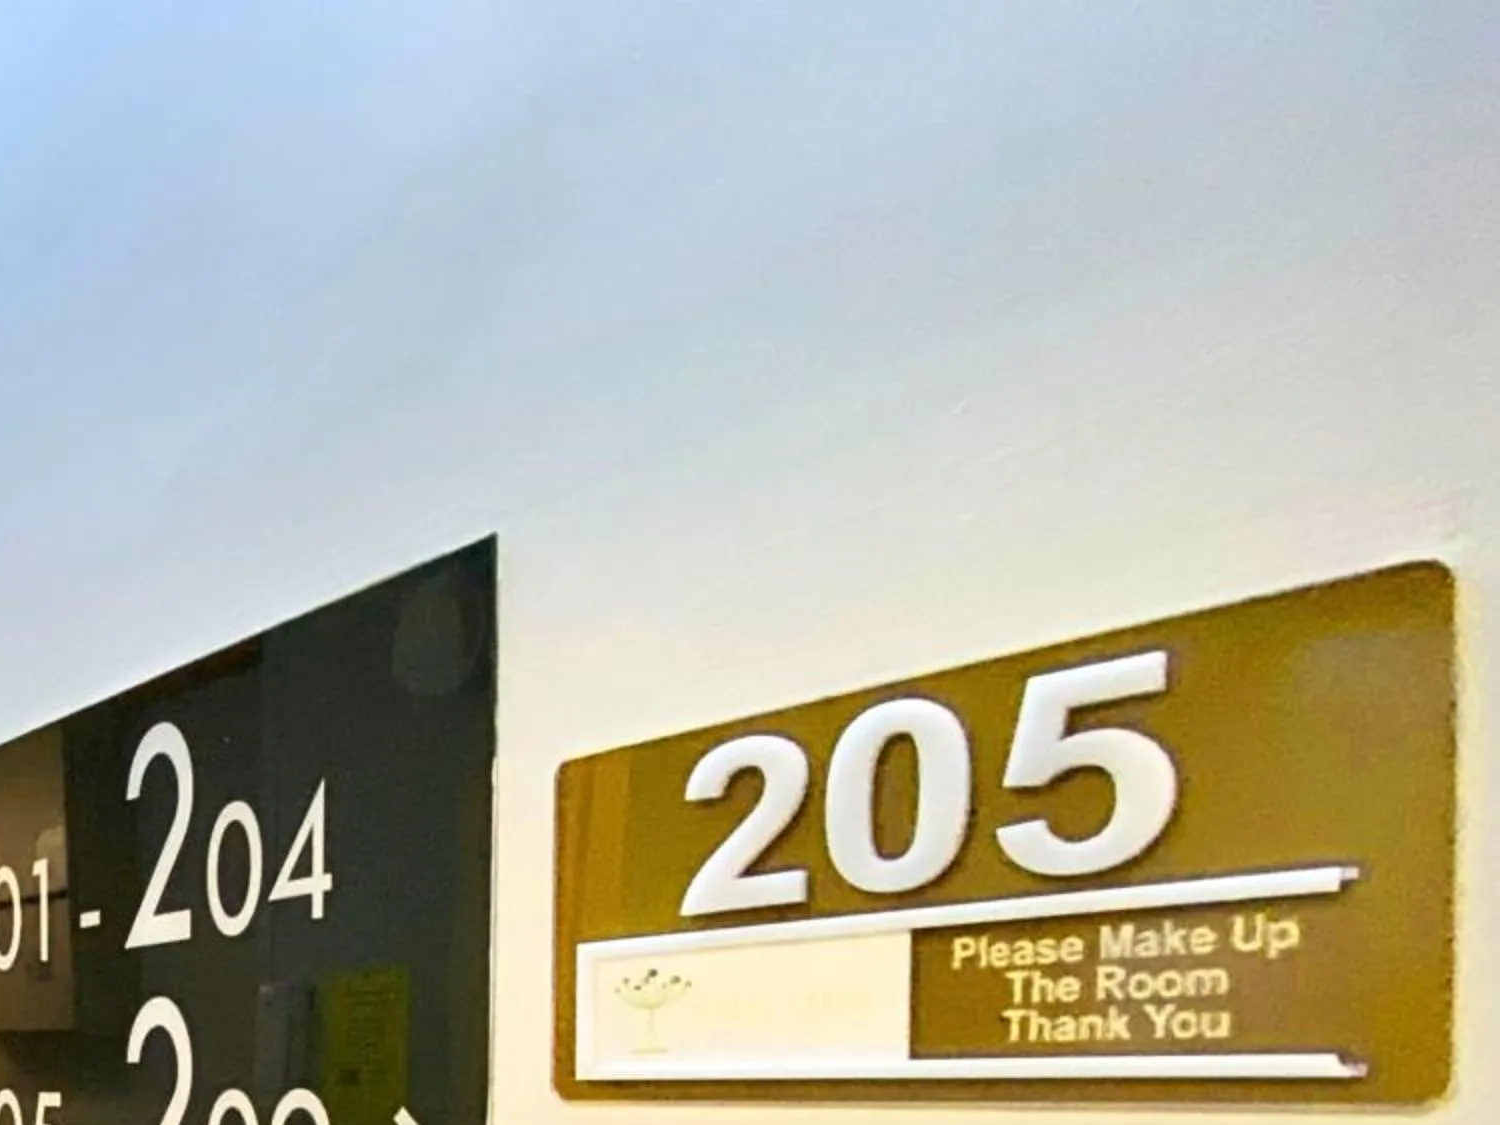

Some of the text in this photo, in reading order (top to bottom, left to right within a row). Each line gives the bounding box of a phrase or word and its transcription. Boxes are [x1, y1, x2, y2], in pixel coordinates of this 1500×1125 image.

[680, 650, 1179, 917] 205
[124, 721, 333, 949] 204
[950, 914, 1300, 970] Please Make Up
[1004, 965, 1230, 1005] The Room
[1001, 1004, 1231, 1043] Thank You
